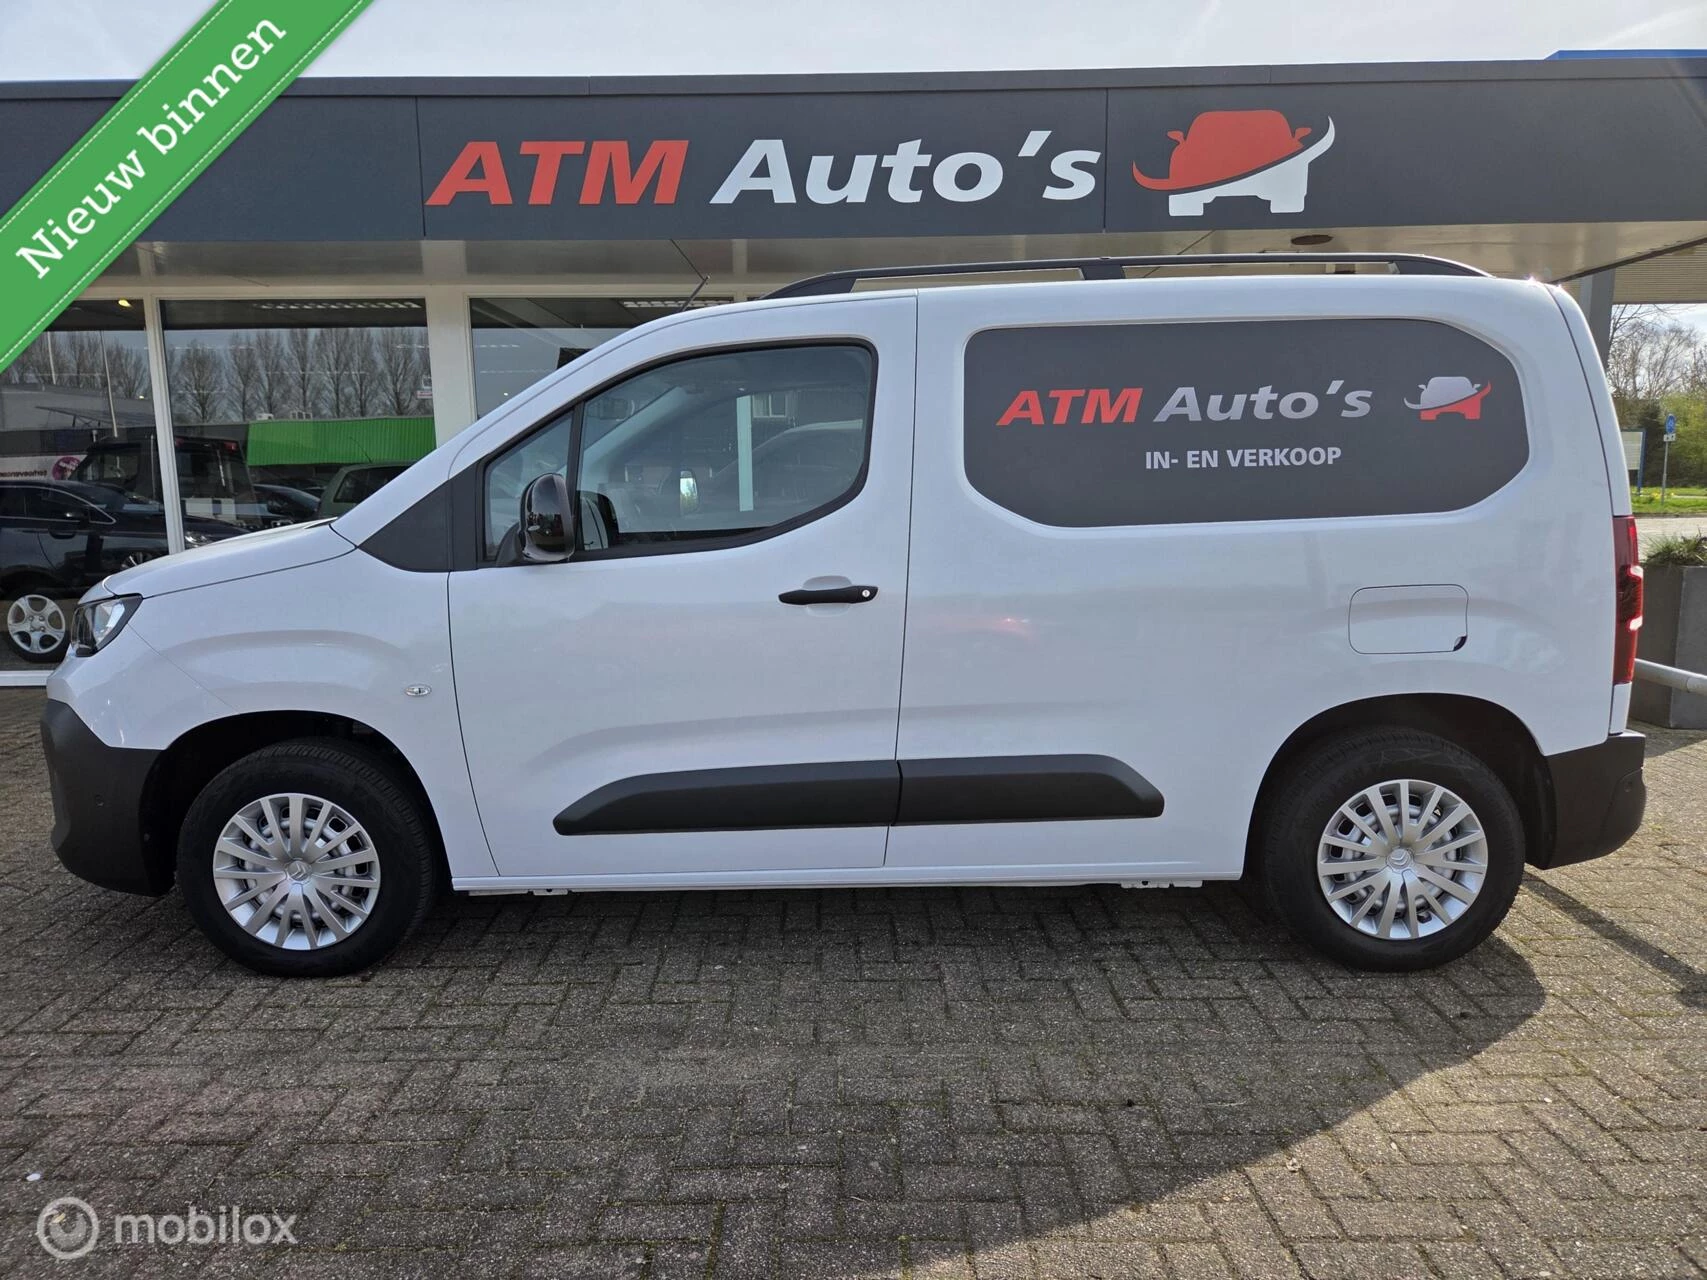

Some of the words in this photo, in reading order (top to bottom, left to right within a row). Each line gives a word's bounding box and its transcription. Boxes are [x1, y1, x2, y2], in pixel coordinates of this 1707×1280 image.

[425, 139, 690, 206] ATM
[709, 130, 1101, 205] Auto's
[996, 387, 1143, 426] ATM
[1153, 380, 1373, 423] Auto's
[1145, 451, 1179, 469] IN-
[1186, 450, 1219, 468] EN
[1226, 446, 1342, 467] VERKOOP
